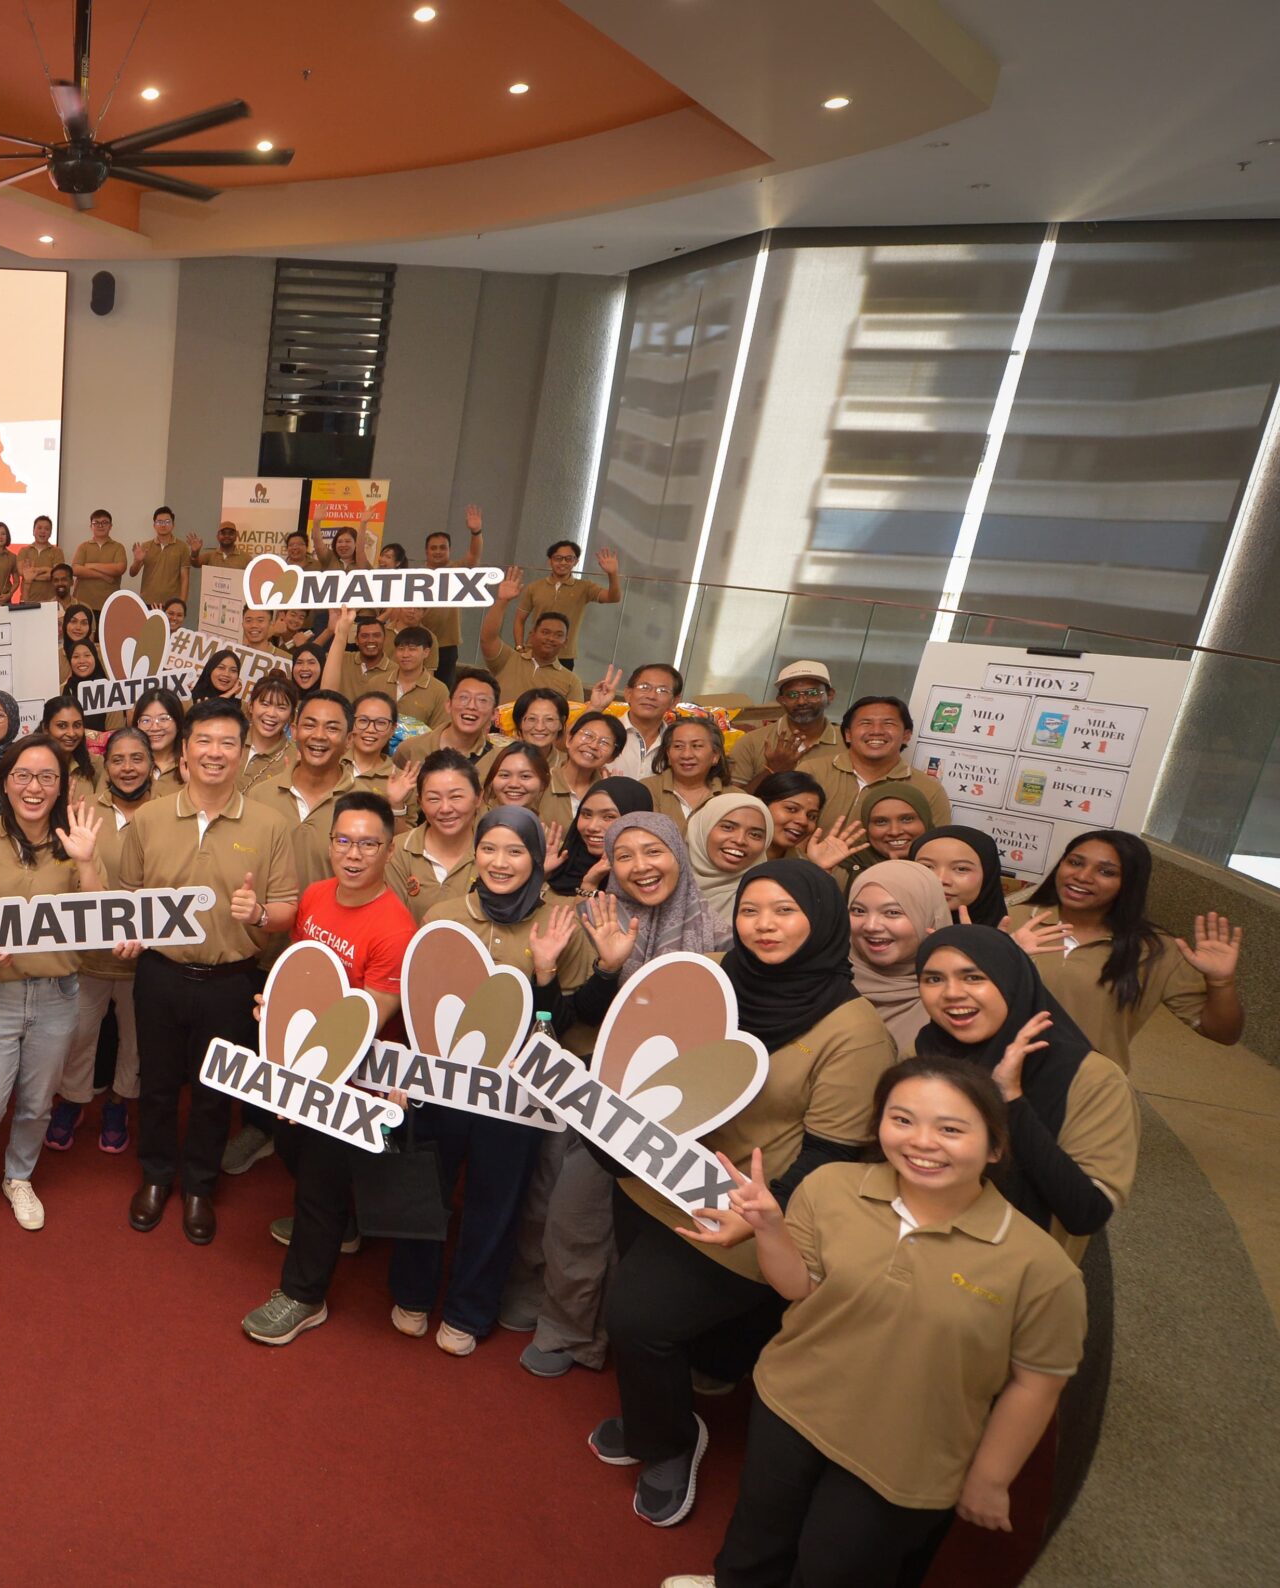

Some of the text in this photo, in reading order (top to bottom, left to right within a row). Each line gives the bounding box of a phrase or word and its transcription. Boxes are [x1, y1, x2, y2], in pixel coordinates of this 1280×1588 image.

[237, 530, 288, 543] MATRIX
[300, 572, 487, 604] MATRIX
[992, 673, 1065, 690] STATION
[1069, 681, 1079, 692] 2
[972, 709, 1005, 721] MILO
[986, 725, 996, 736] 1
[1087, 719, 1117, 730] MILK
[1073, 727, 1125, 741] POWDER
[1098, 740, 1107, 753] 1
[953, 762, 999, 776] INSTANT
[948, 771, 999, 785] OATMEAL
[970, 783, 984, 796] 3
[1052, 781, 1113, 798] BISCUITS
[1078, 800, 1091, 813] 4
[991, 827, 1039, 842] INSTANT
[995, 837, 1038, 851] OODLES
[1010, 849, 1024, 862] 6
[308, 923, 356, 960] KECHARA
[205, 1044, 386, 1146] MATRIX
[517, 1041, 738, 1210] MATRIX
